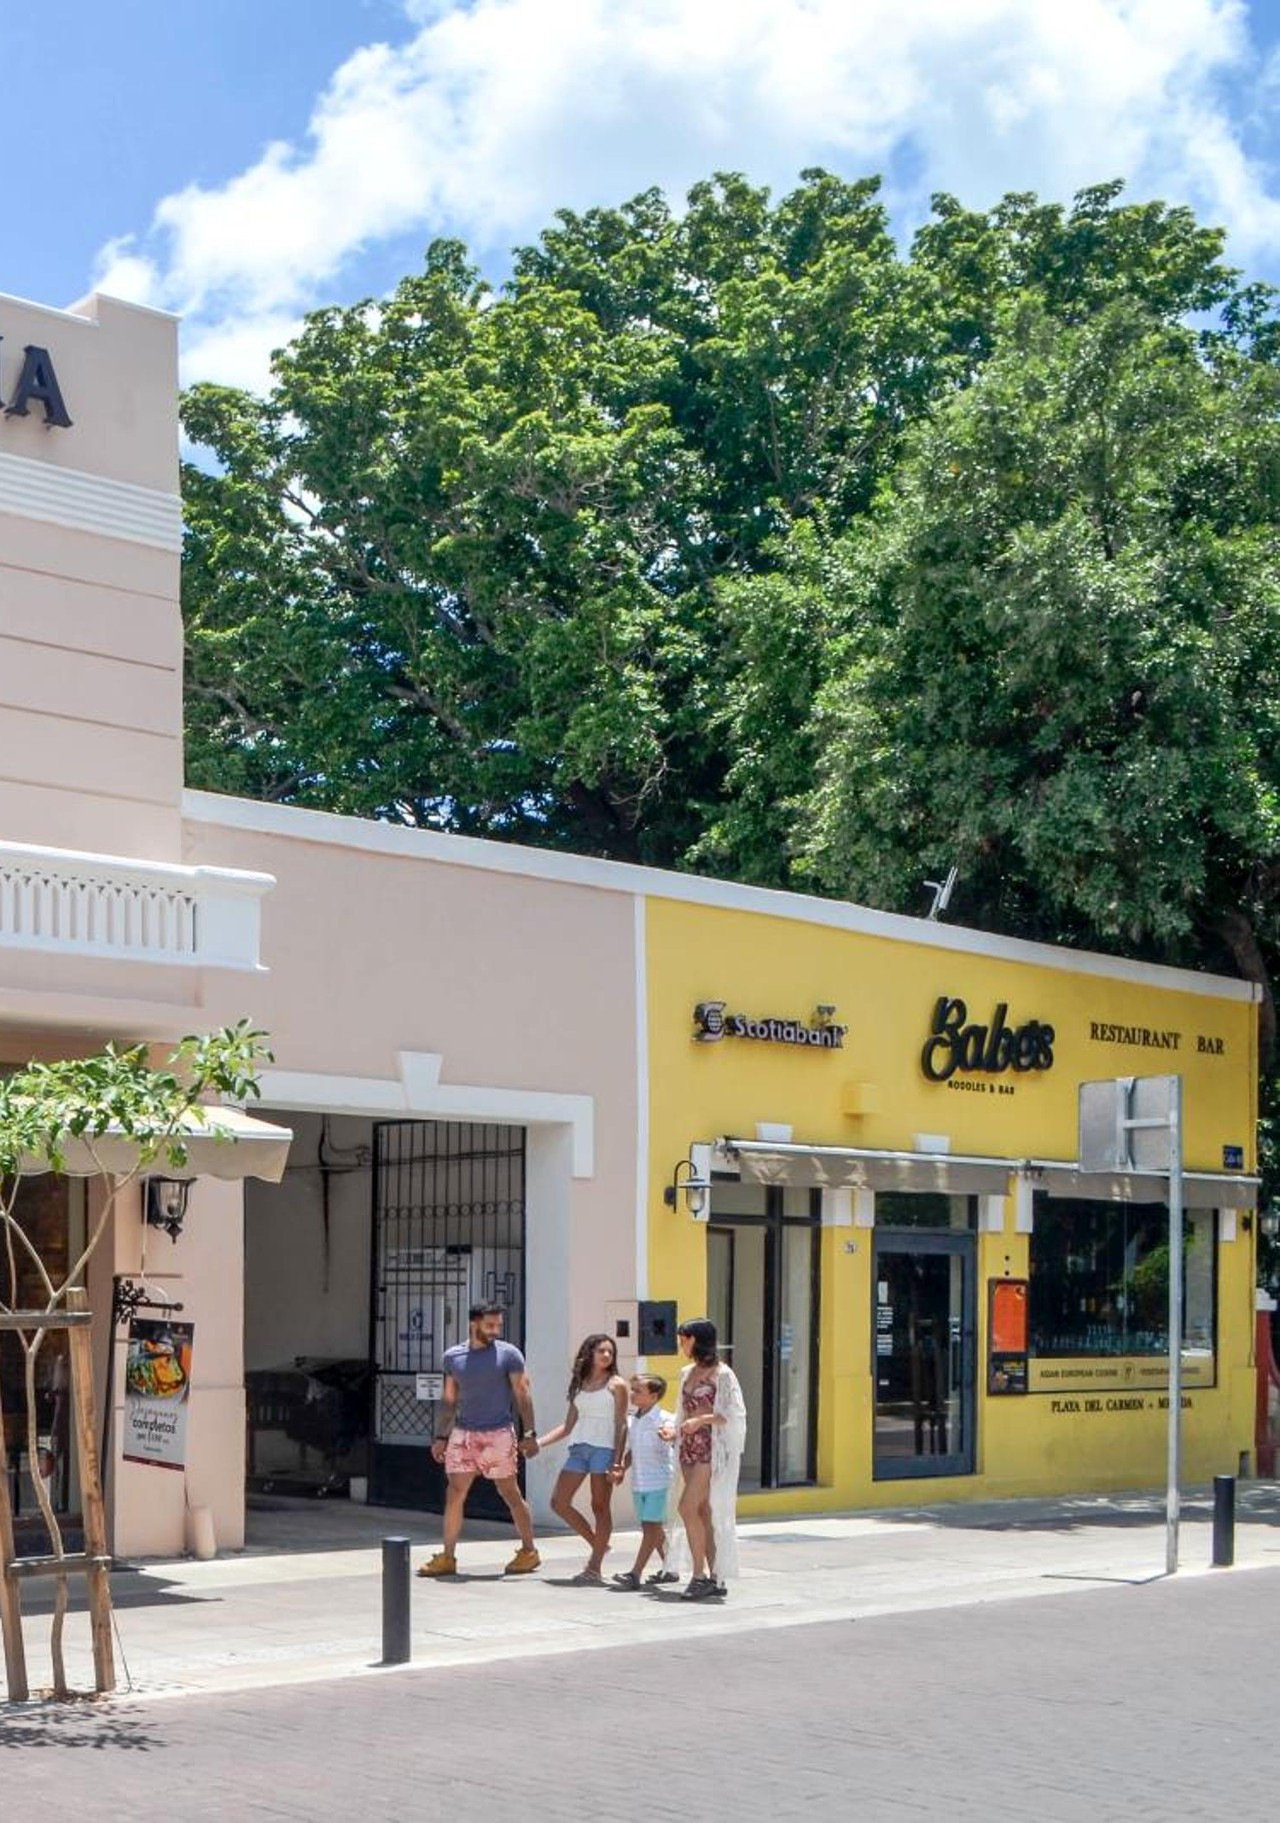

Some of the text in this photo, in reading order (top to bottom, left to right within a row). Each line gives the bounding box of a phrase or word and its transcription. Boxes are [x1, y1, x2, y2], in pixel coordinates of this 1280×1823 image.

[733, 1011, 844, 1048] Scotiabank
[921, 996, 1056, 1082] Babes
[1090, 1022, 1225, 1055] RESTAURANT BAR
[948, 1080, 986, 1093] NOODLES
[998, 1084, 1015, 1095] BAR
[1051, 1400, 1080, 1413] PLAYA
[1084, 1400, 1103, 1412] DEL
[1106, 1398, 1145, 1411] CARMEN
